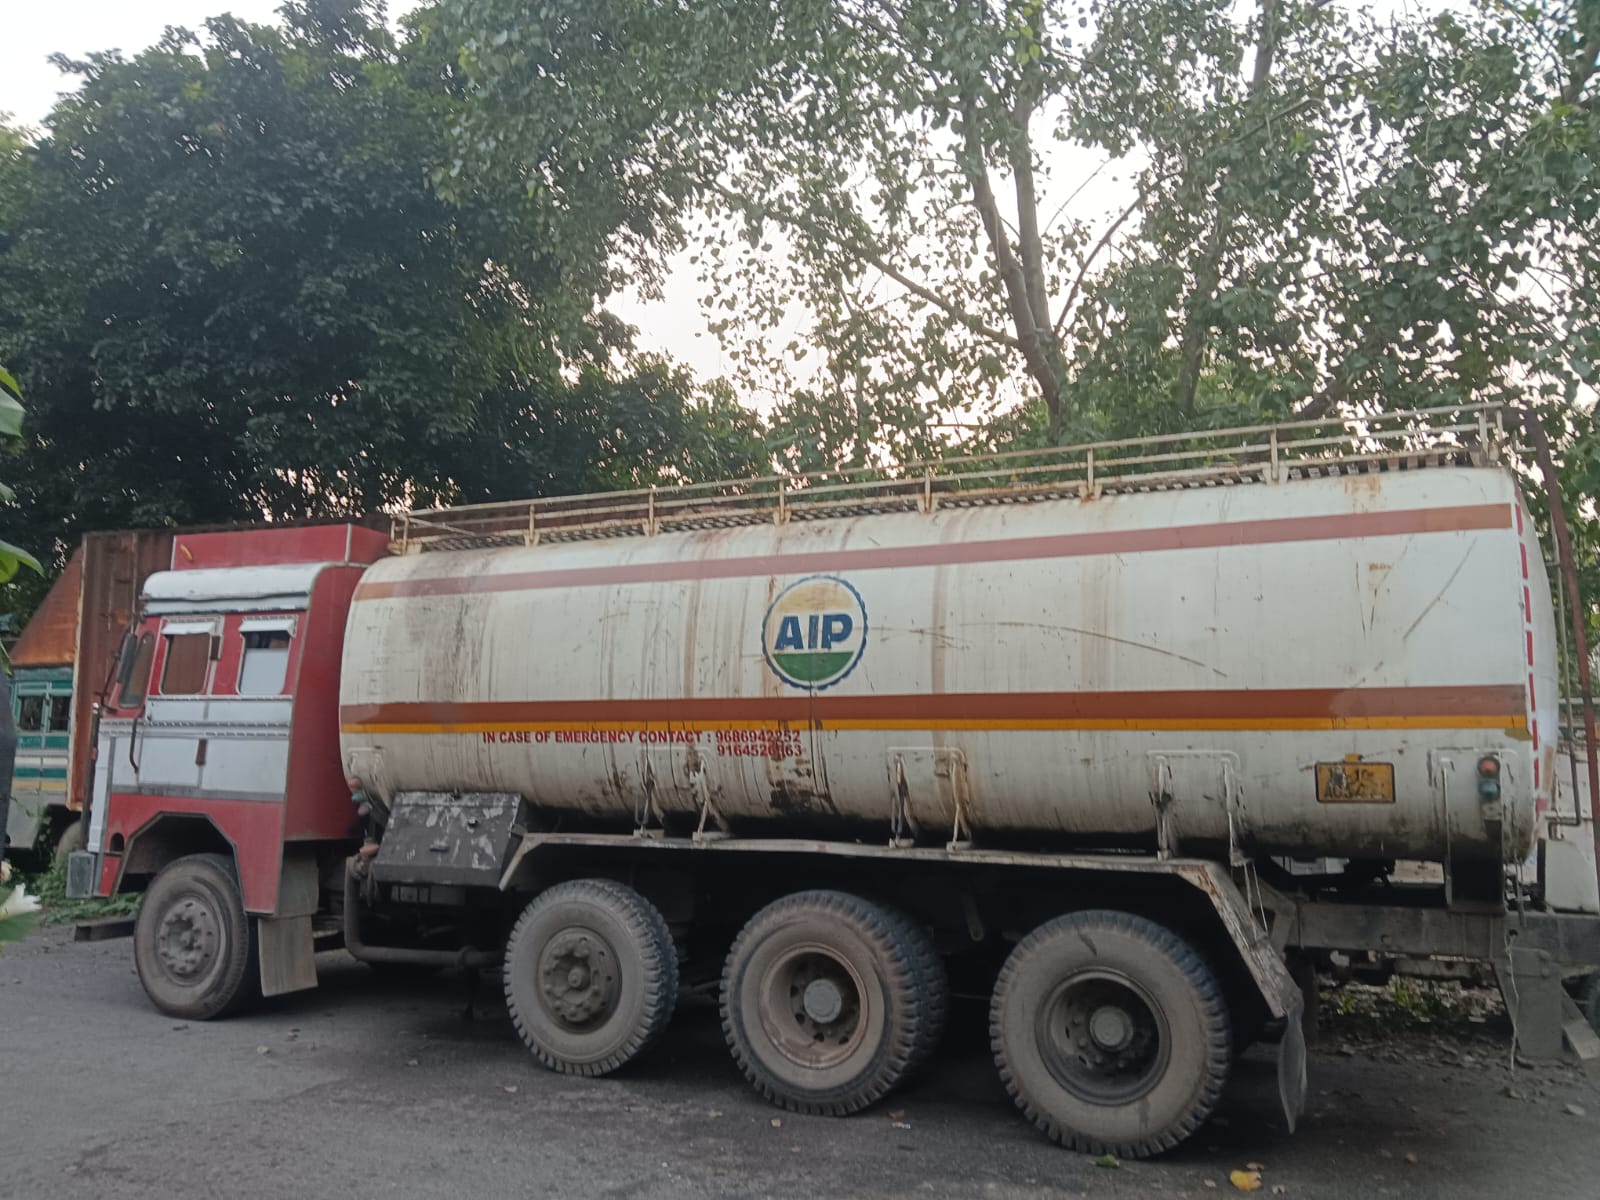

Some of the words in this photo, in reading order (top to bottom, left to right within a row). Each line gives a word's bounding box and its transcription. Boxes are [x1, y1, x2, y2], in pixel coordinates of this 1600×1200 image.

[774, 613, 853, 650] AIP
[483, 731, 496, 743] IN
[499, 731, 531, 743] CASE
[535, 731, 550, 743] OF
[555, 730, 634, 743] EMERGENCY
[639, 730, 702, 743] CONTACT
